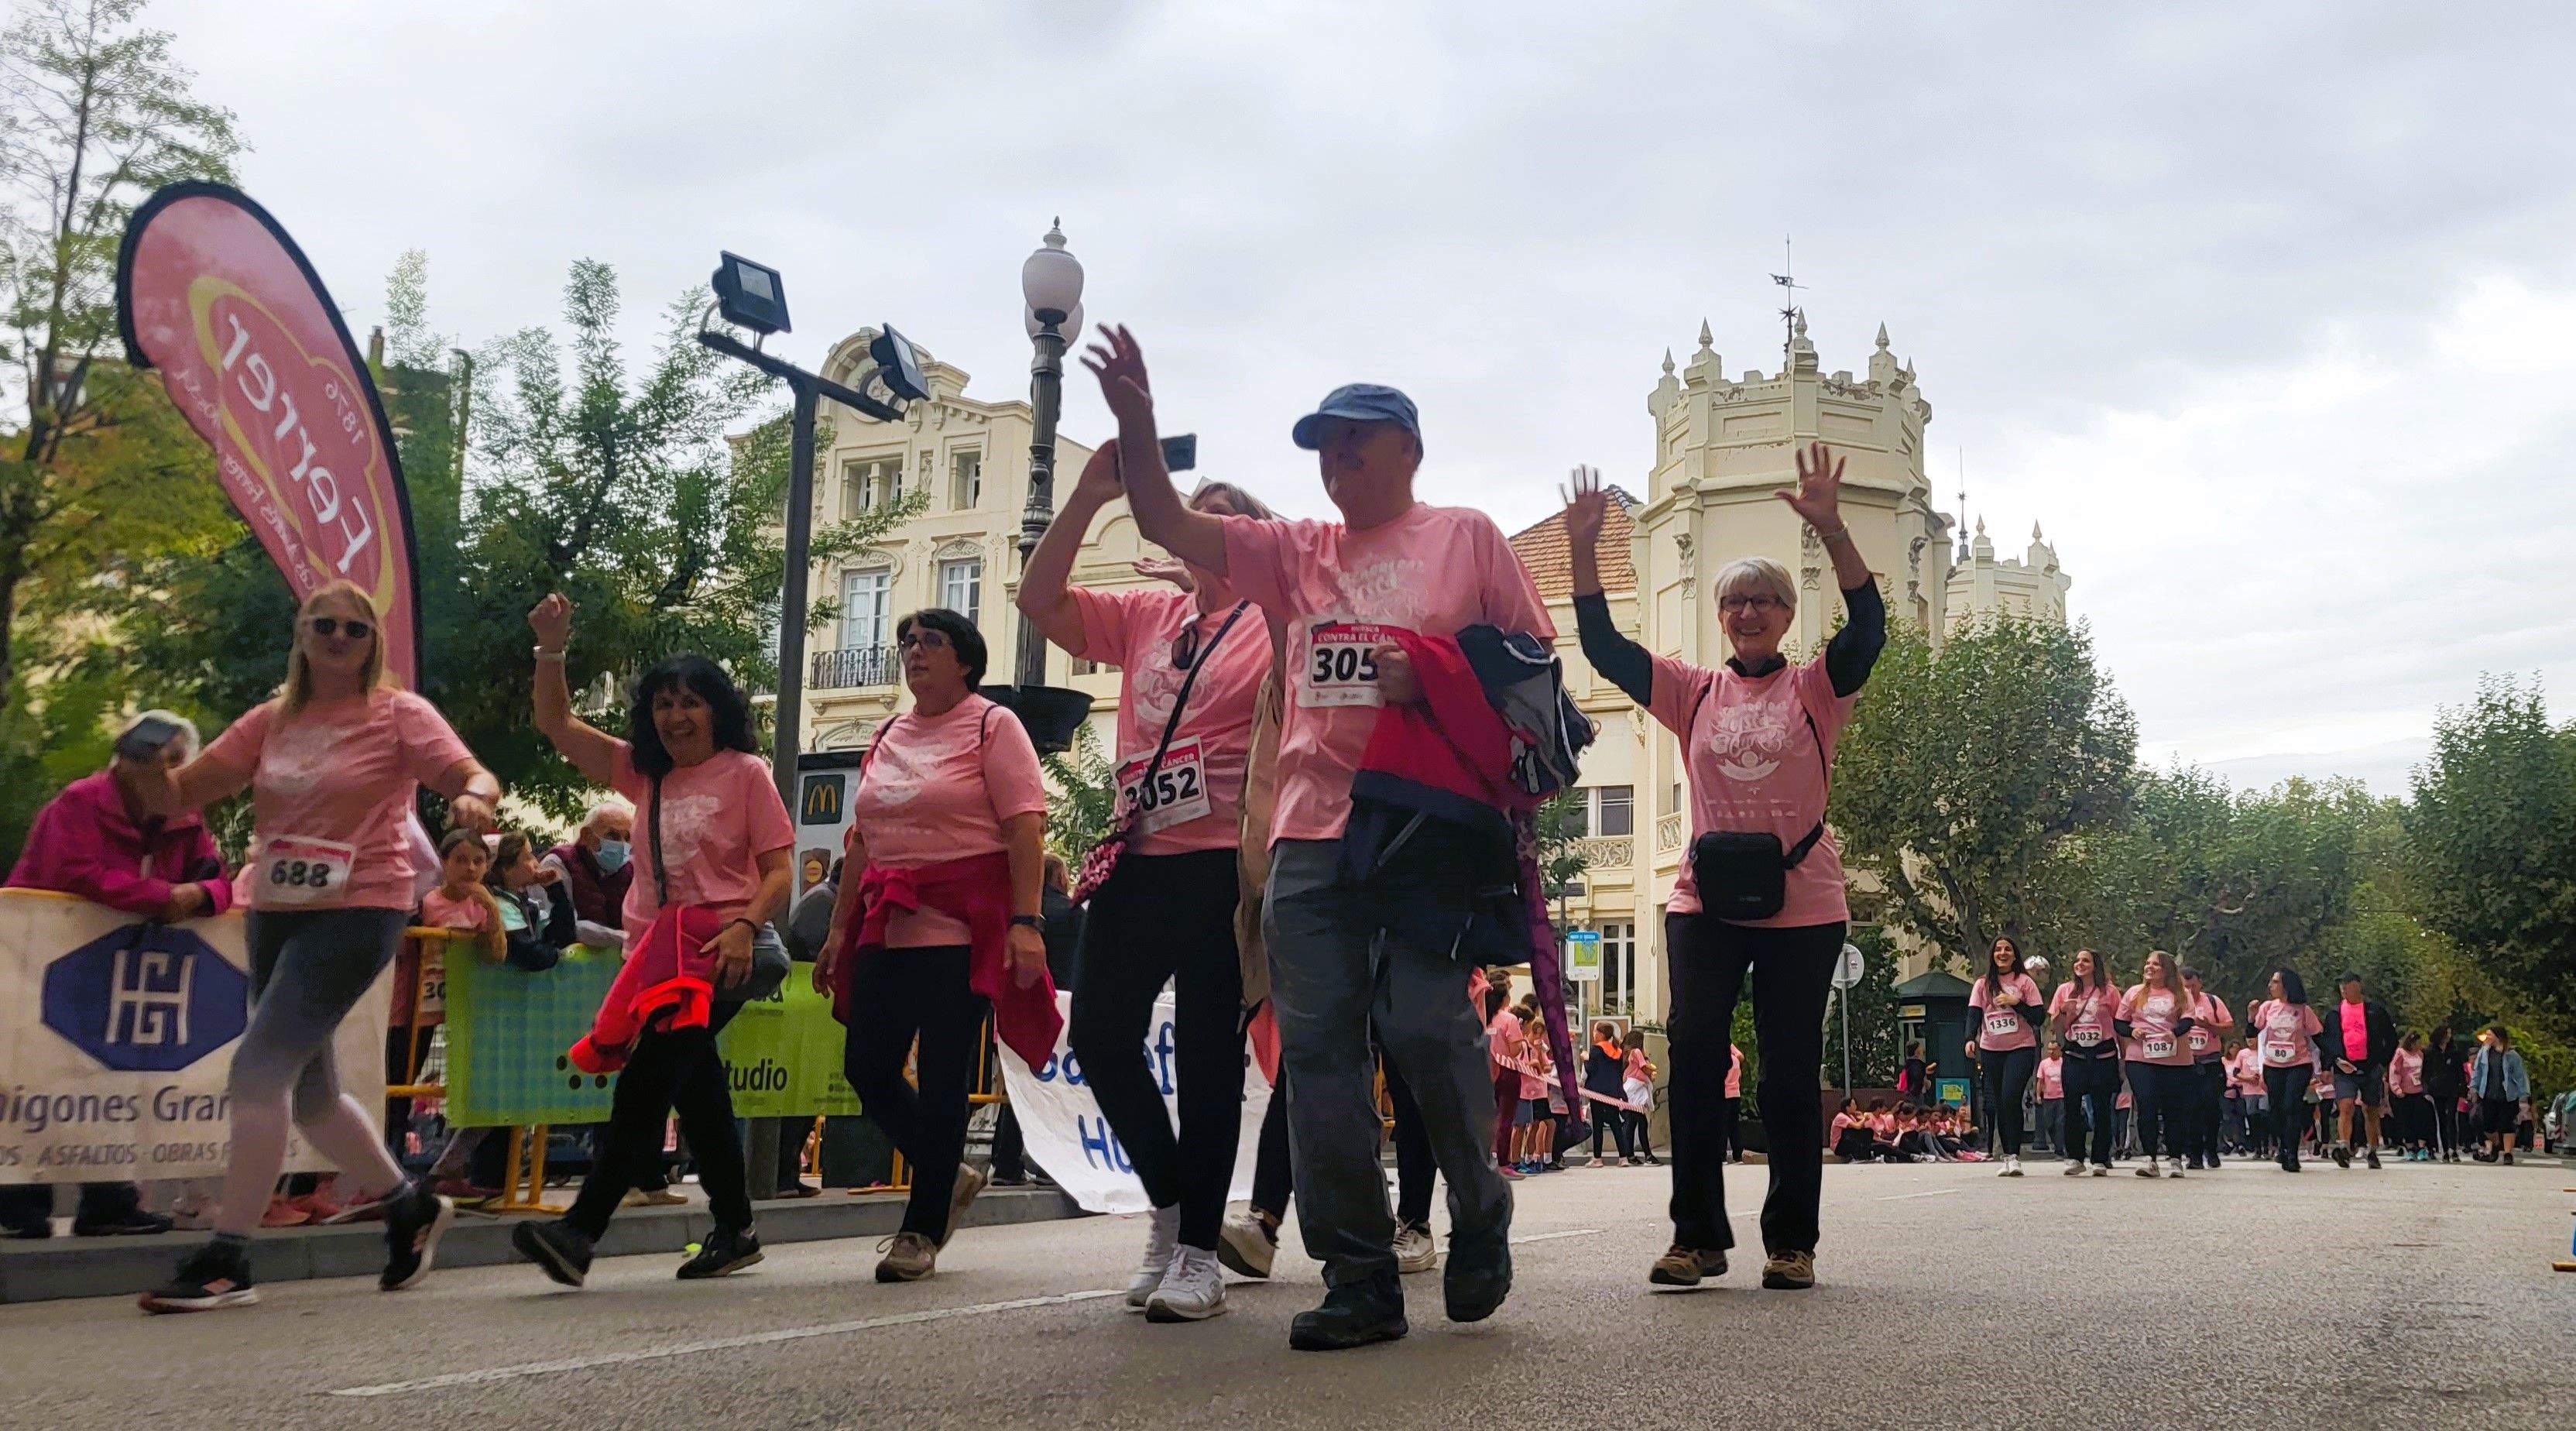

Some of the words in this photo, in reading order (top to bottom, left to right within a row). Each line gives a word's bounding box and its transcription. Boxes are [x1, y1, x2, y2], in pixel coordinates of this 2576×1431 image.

[1312, 647, 1379, 682] 305
[271, 860, 331, 887] 688
[1989, 1017, 2016, 1030] 1336
[725, 1058, 788, 1092] tudio
